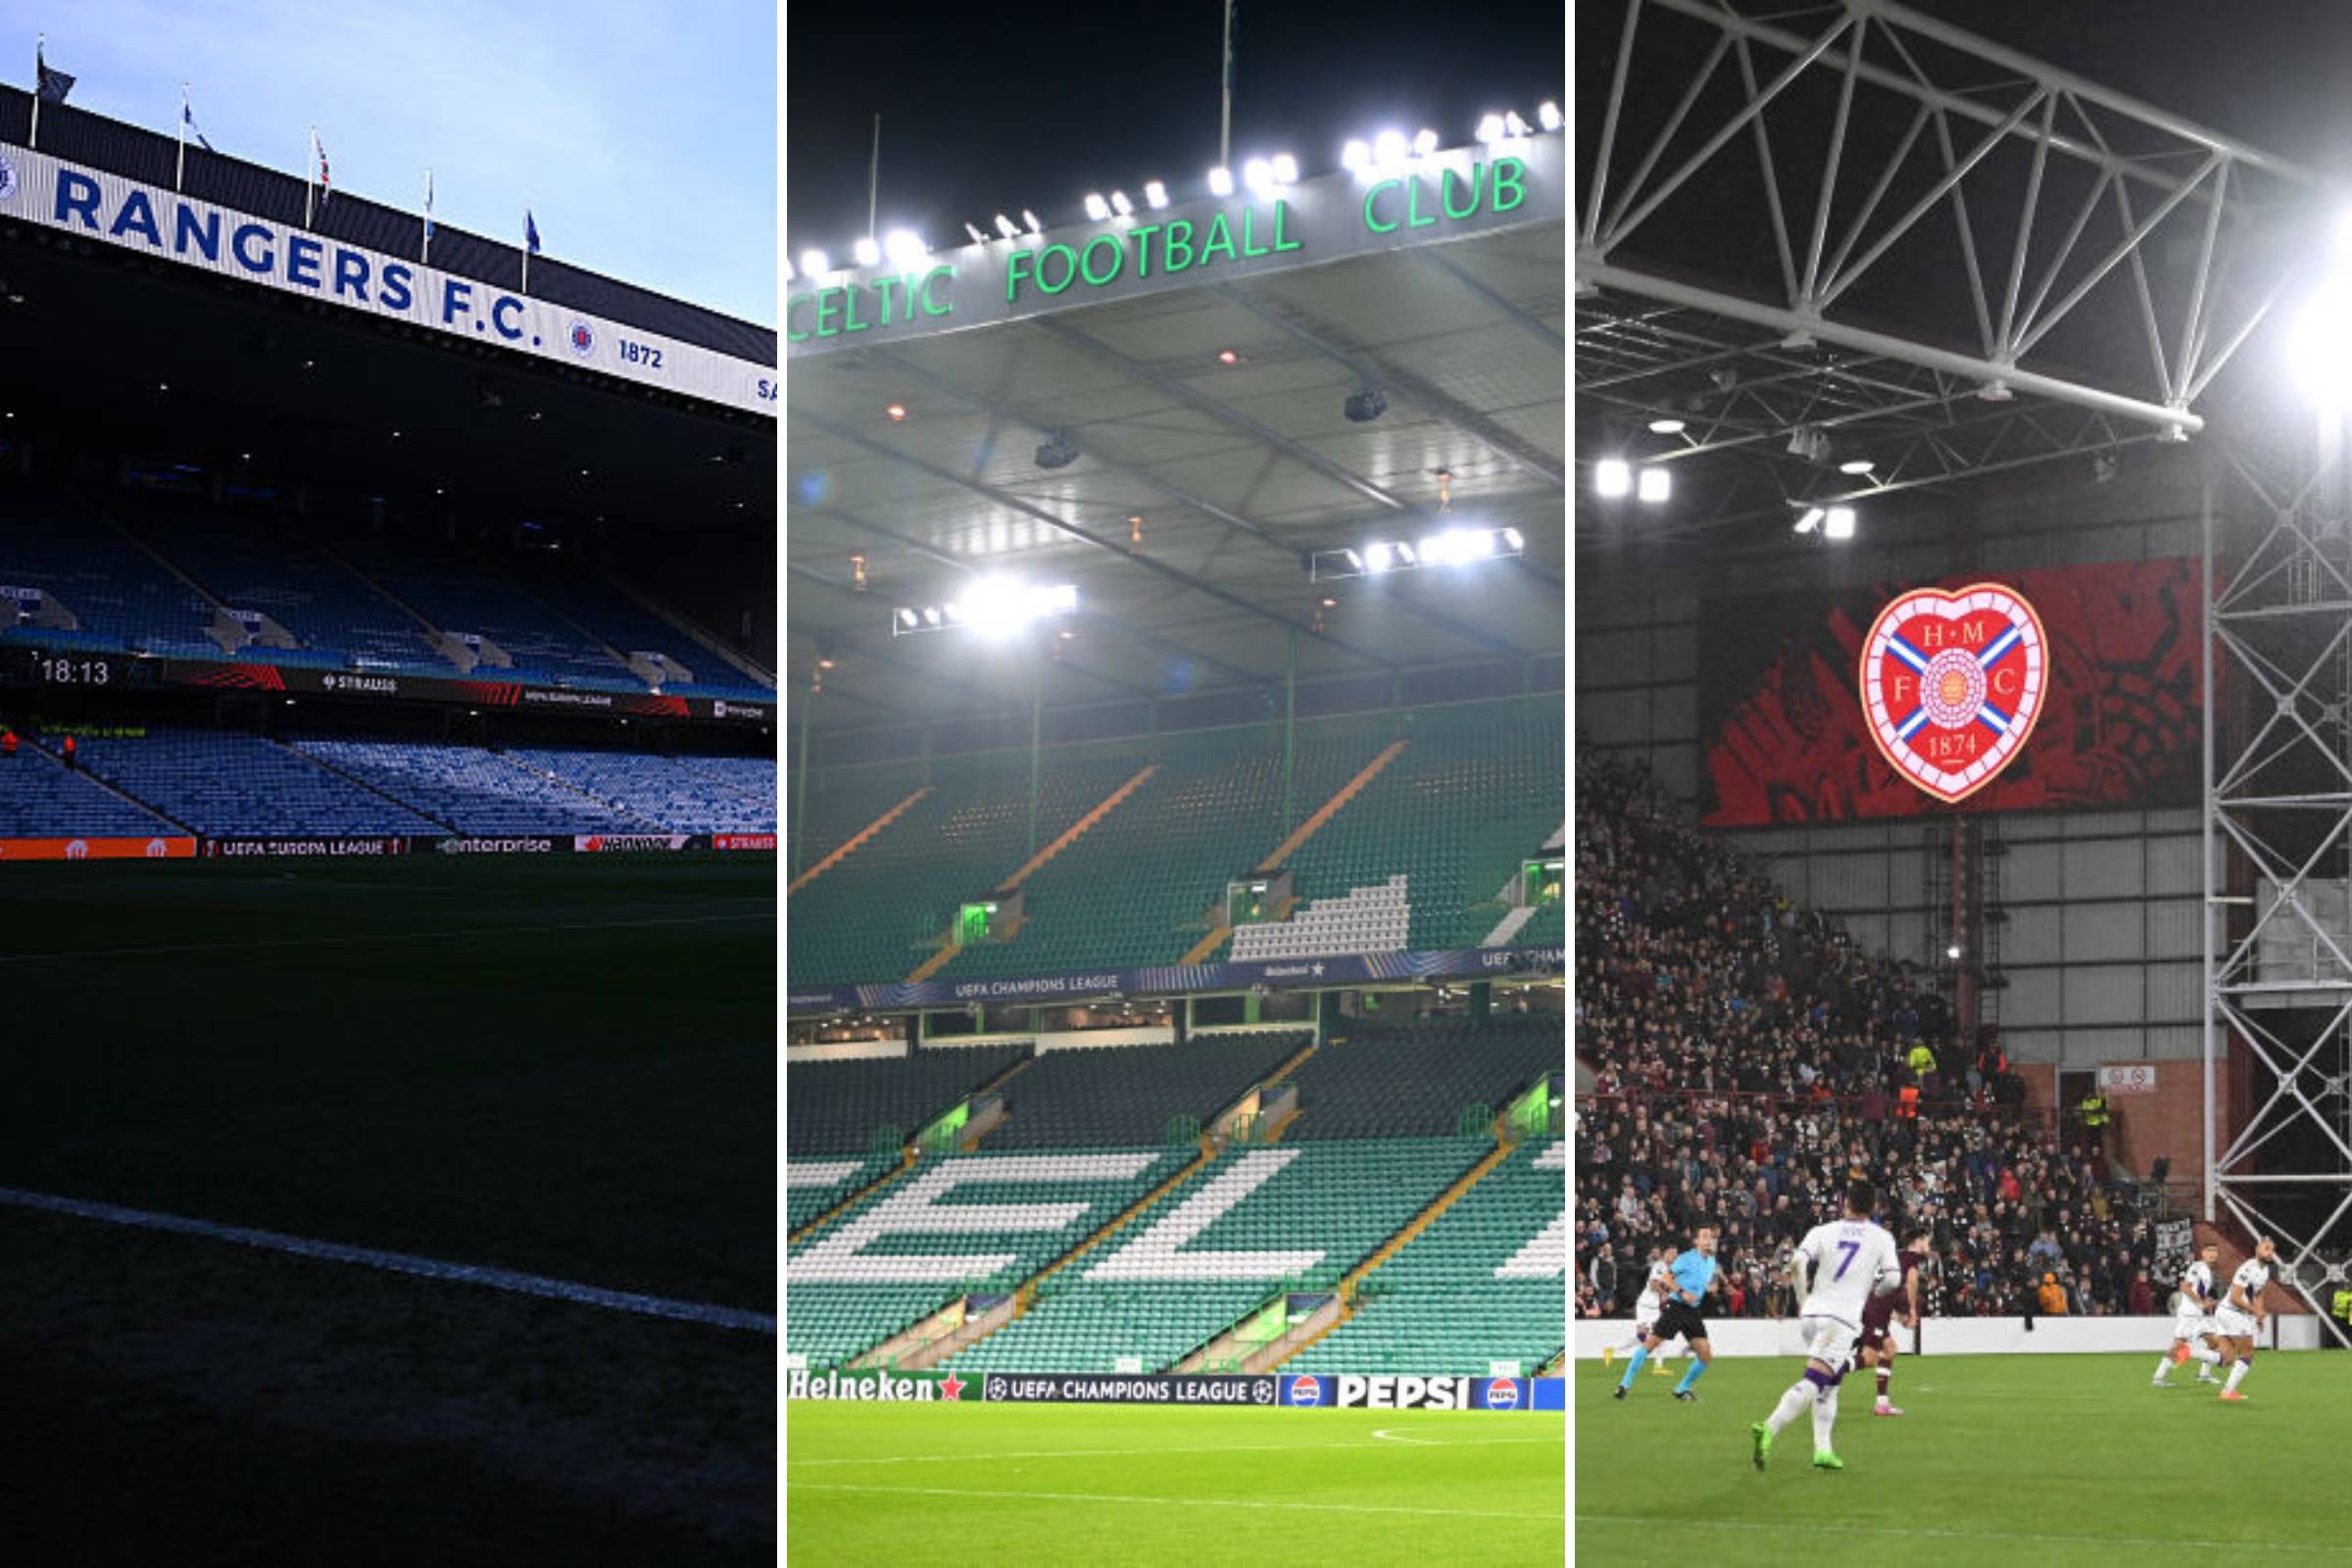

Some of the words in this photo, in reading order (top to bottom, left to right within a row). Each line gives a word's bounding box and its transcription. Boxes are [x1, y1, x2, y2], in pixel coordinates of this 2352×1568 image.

[53, 167, 413, 312] RANGERS
[441, 278, 543, 348] F.C.
[787, 265, 957, 343] CELTIC
[1005, 199, 1302, 303] FOOTBALL
[1363, 156, 1528, 235] CLUB
[618, 338, 662, 368] 1872
[41, 659, 109, 686] 18:13
[1929, 733, 1977, 758] 1874
[223, 840, 266, 856] UEFA
[329, 840, 384, 855] LEAGUE
[1482, 952, 1521, 967] UEF
[955, 982, 989, 998] UEFA
[992, 977, 1065, 996] CHAMPIONS
[1069, 974, 1119, 991] LEAGUE
[1833, 1240, 1861, 1283] 7
[787, 1370, 934, 1401] Heineken
[1012, 1375, 1057, 1398] UEFA
[1063, 1376, 1170, 1401] CHAMPIONS
[1176, 1378, 1248, 1402] LEAGUE
[1338, 1375, 1468, 1409] PEPSI
